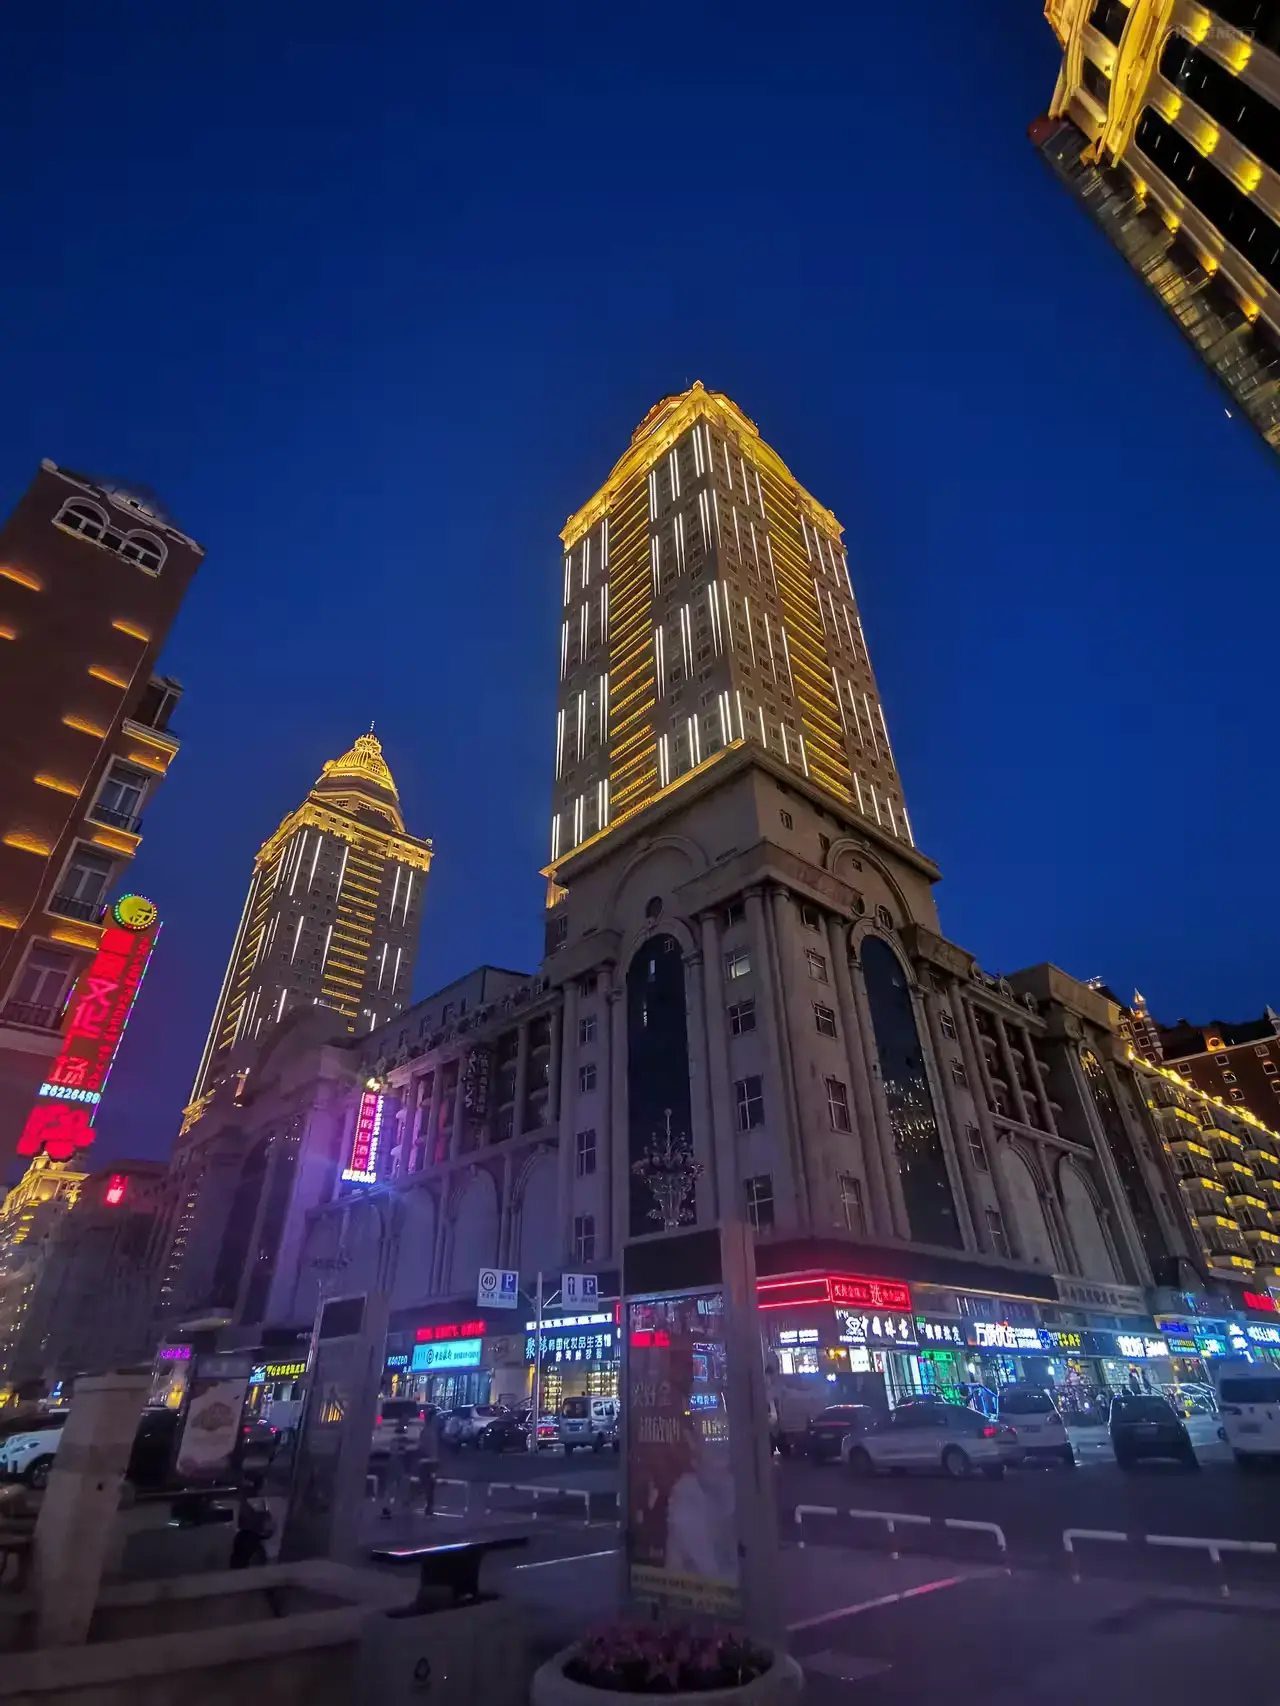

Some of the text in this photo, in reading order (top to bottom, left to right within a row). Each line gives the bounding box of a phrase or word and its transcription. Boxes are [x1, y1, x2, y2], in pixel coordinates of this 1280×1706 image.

[484, 1276, 493, 1285] 40
[505, 1273, 513, 1288] P
[586, 1280, 593, 1293] P
